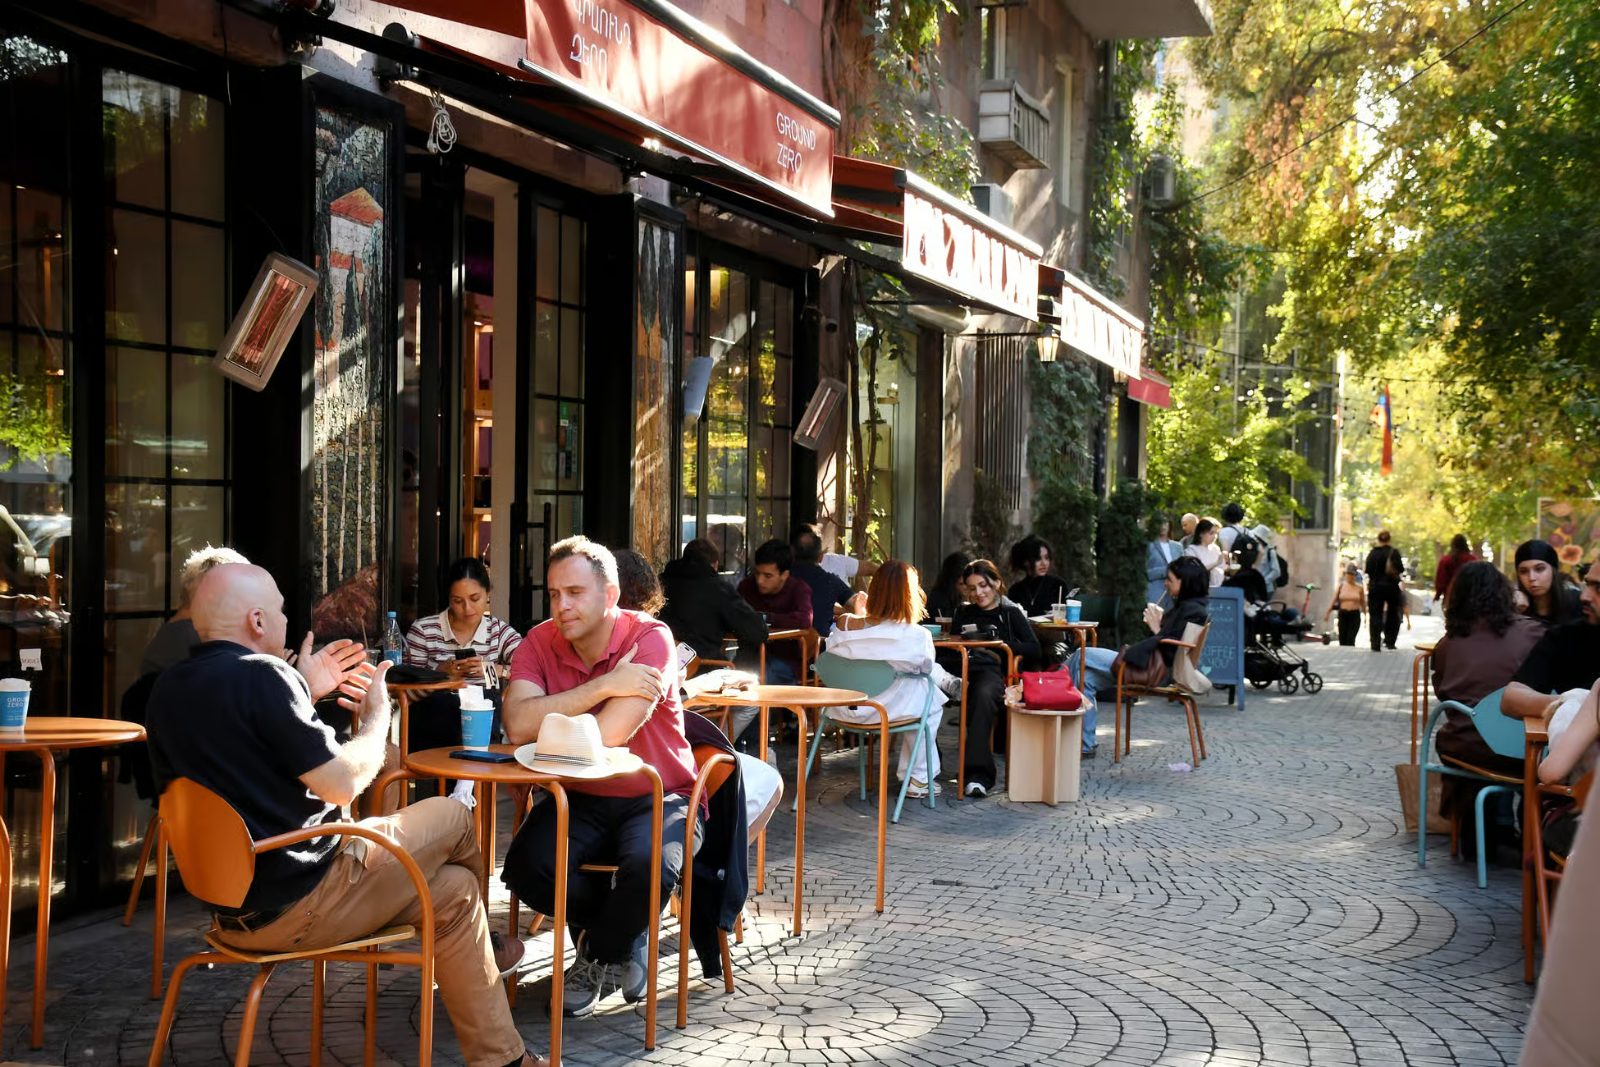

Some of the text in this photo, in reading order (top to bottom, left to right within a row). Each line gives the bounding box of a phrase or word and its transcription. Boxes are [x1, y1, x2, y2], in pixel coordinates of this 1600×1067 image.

[776, 112, 816, 151] GROUND
[777, 142, 802, 174] ZERO
[485, 665, 498, 686] 19
